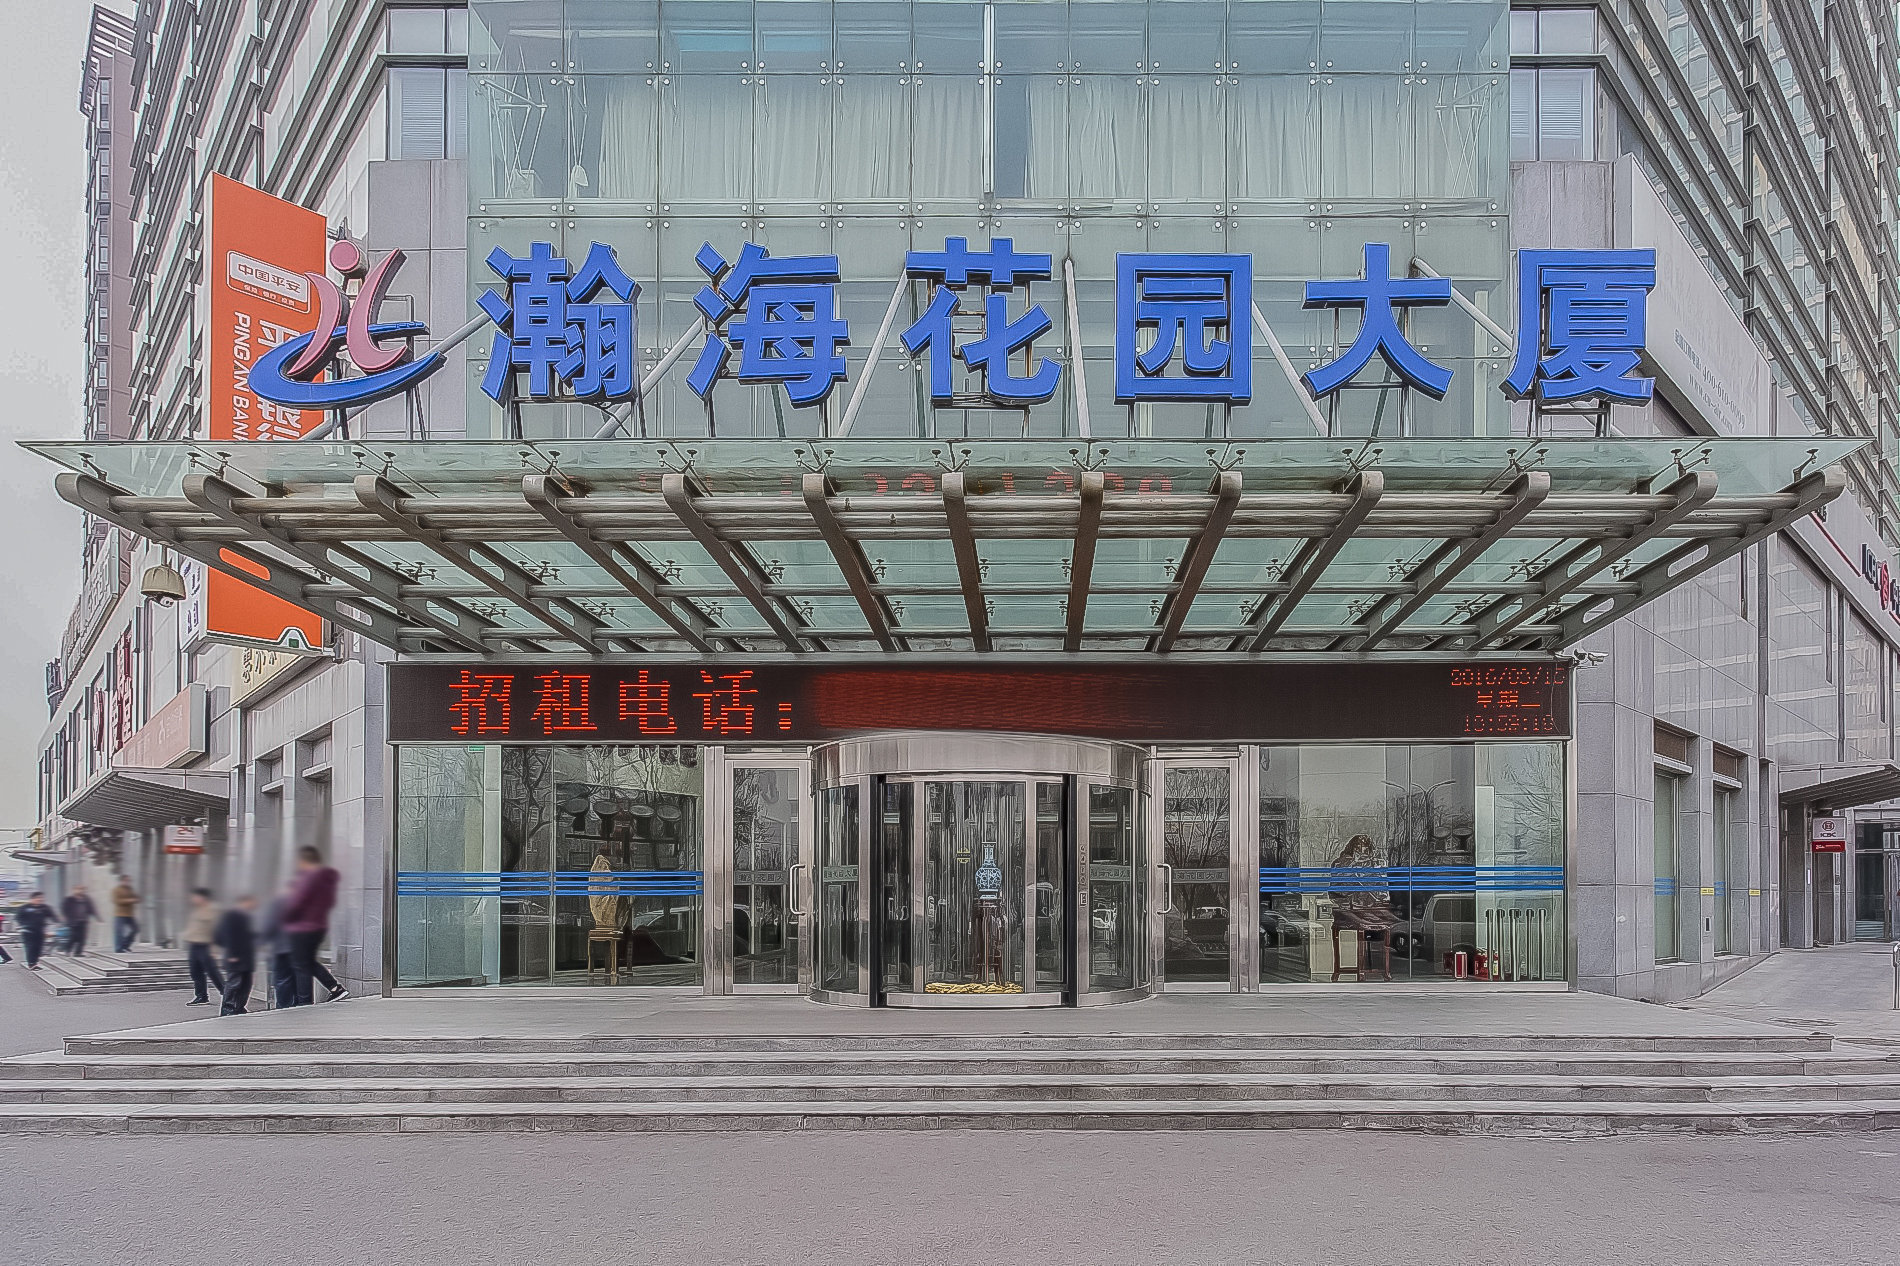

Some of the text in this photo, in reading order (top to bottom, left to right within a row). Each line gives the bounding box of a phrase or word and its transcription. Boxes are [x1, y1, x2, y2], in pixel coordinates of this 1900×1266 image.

[238, 263, 301, 294] 中国平安
[232, 311, 251, 393] PINGAN
[475, 236, 1657, 404] 瀚海花园大厦
[448, 670, 793, 735] 招租电话:
